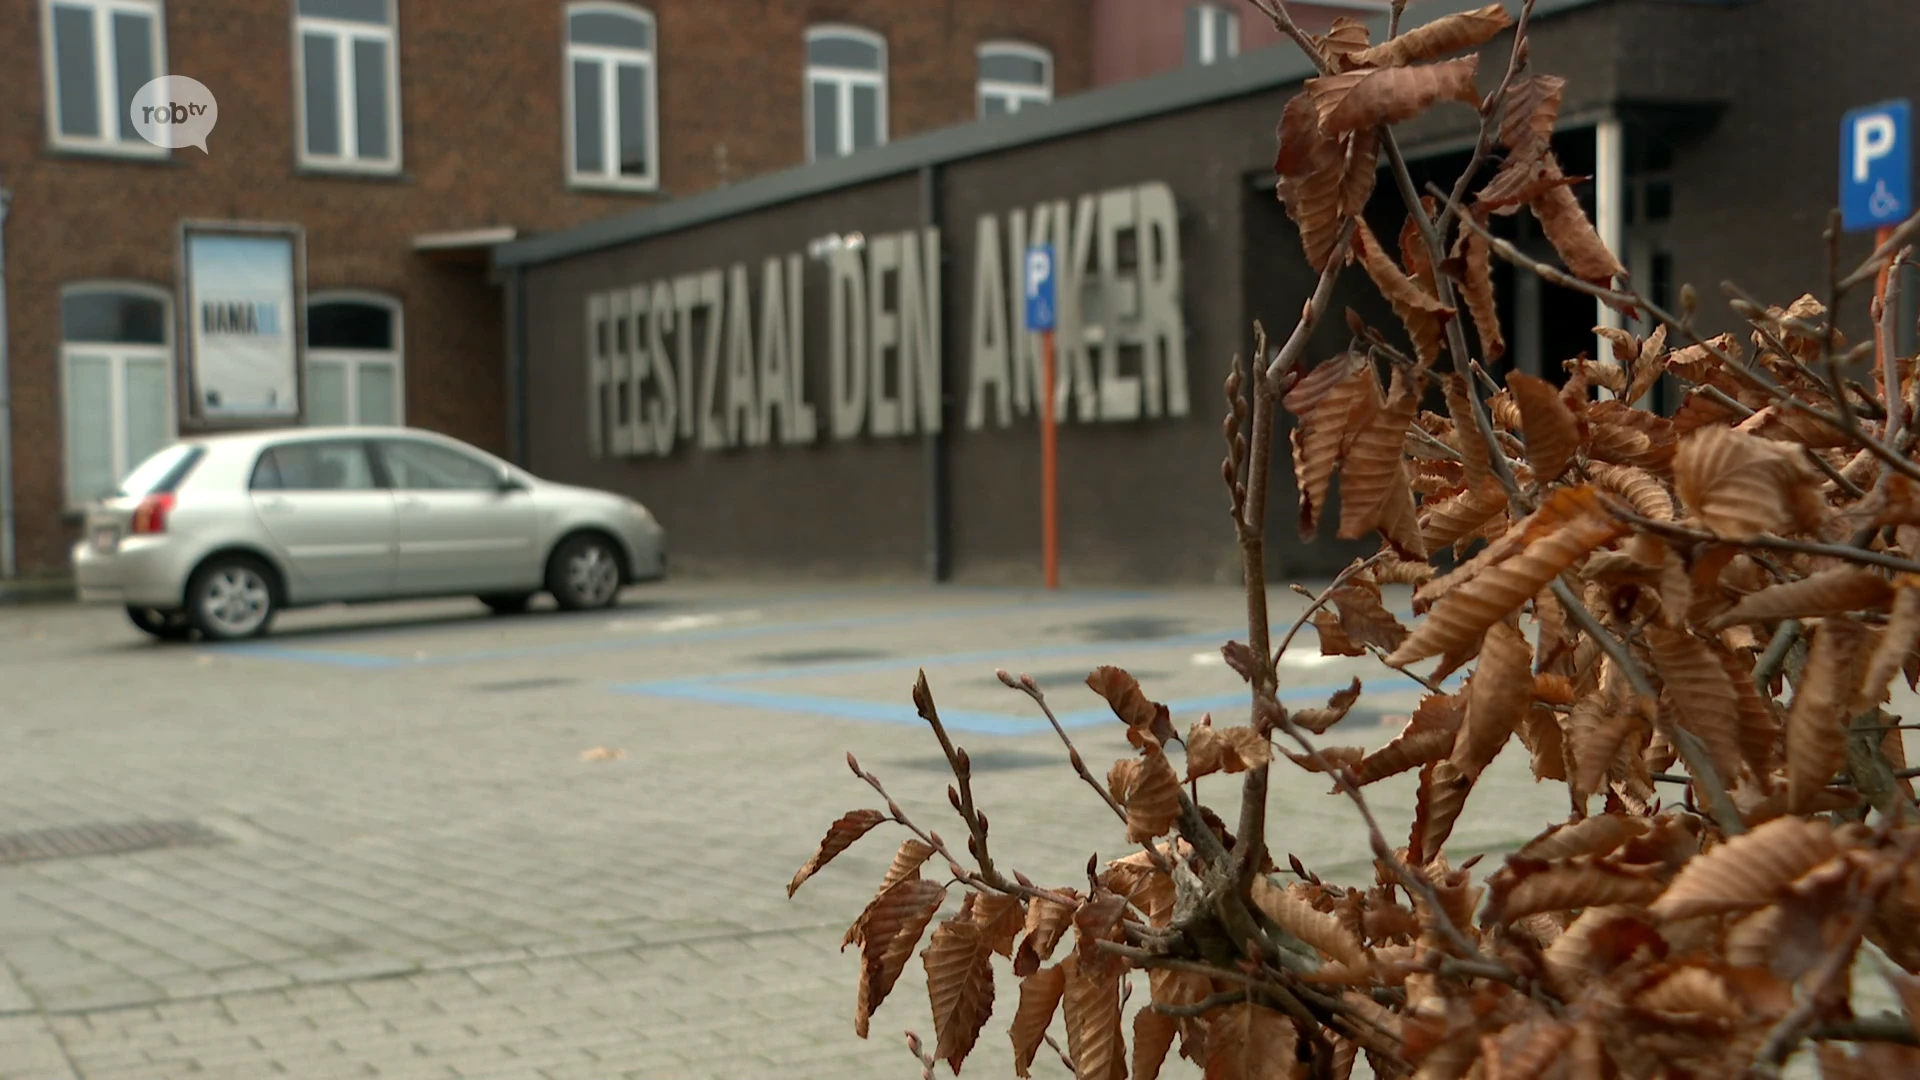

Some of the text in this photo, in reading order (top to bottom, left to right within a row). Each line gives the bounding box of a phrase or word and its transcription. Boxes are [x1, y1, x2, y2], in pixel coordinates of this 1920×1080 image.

[1853, 114, 1896, 183] P
[1027, 251, 1051, 297] P
[587, 252, 816, 456] FEESTZAAL
[829, 226, 942, 438] DEN
